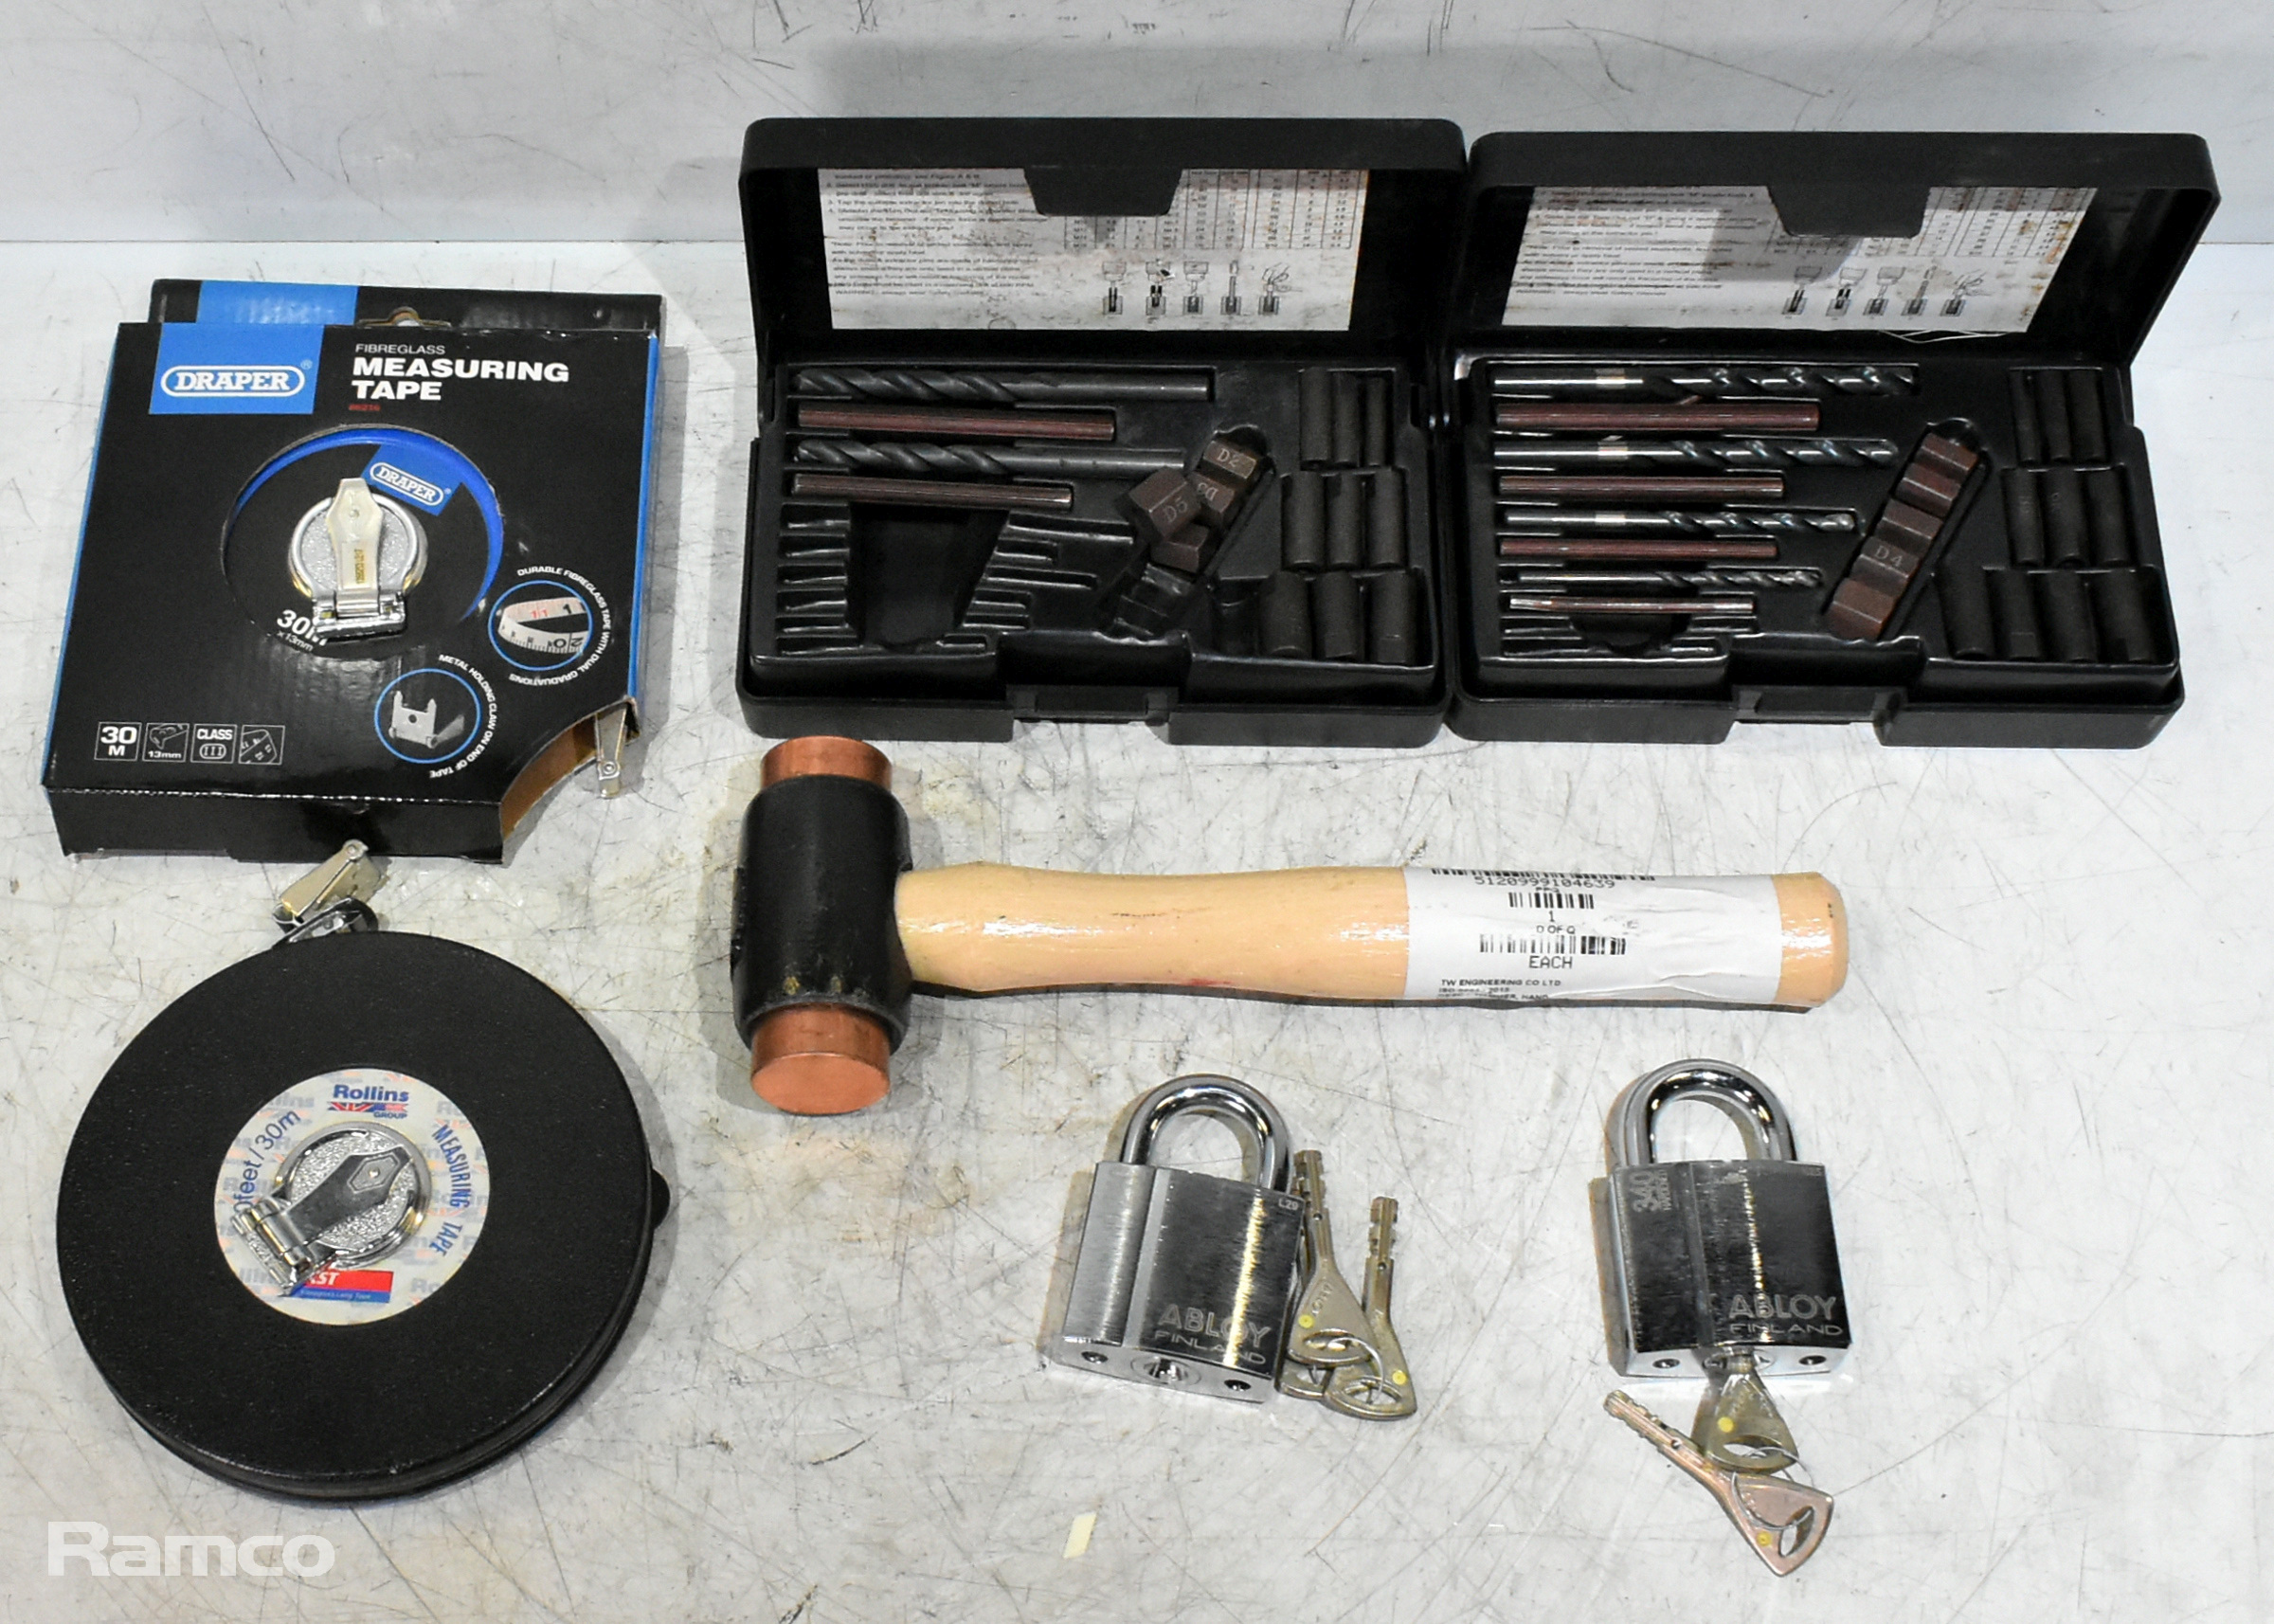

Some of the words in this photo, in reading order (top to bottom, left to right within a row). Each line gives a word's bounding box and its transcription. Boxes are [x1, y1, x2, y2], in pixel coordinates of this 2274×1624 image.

[354, 343, 446, 355] FIBREGLASS
[352, 356, 569, 383] MEASURING
[173, 371, 291, 391] DRAPER
[351, 379, 442, 401] TAPE
[1217, 447, 1242, 468] D2
[375, 465, 437, 502] DRAPER
[1873, 545, 1904, 568] D4
[516, 566, 564, 577] DURABLE
[563, 569, 607, 609] FIBREGLASS
[601, 608, 611, 630] TAPE
[594, 631, 611, 655] WITH
[439, 654, 469, 671] METAL
[577, 653, 601, 673] DUAL
[468, 667, 496, 702] HOLDING
[508, 671, 579, 686] GRADUATIONS
[488, 702, 497, 731] CLAW
[100, 726, 137, 745] 30
[196, 729, 233, 741] CLASS
[480, 731, 494, 746] ON
[108, 745, 126, 756] M
[148, 750, 182, 759] 13mm
[203, 746, 223, 756] III
[466, 745, 485, 762] END
[429, 766, 455, 779] TAPE
[455, 759, 468, 770] OF
[1548, 911, 1556, 923] 1
[1547, 925, 1562, 934] OF
[1566, 925, 1576, 934] Q
[1528, 955, 1573, 969] EACH
[333, 1084, 409, 1102] Rollins
[373, 1110, 408, 1119] GROUP
[255, 1110, 301, 1151] 30m
[432, 1124, 472, 1209] MEASURING
[429, 1221, 463, 1257] TAPE
[1728, 1292, 1837, 1321] ABLOY
[1157, 1303, 1272, 1348] ABLOY
[1729, 1323, 1844, 1336] FINLAND
